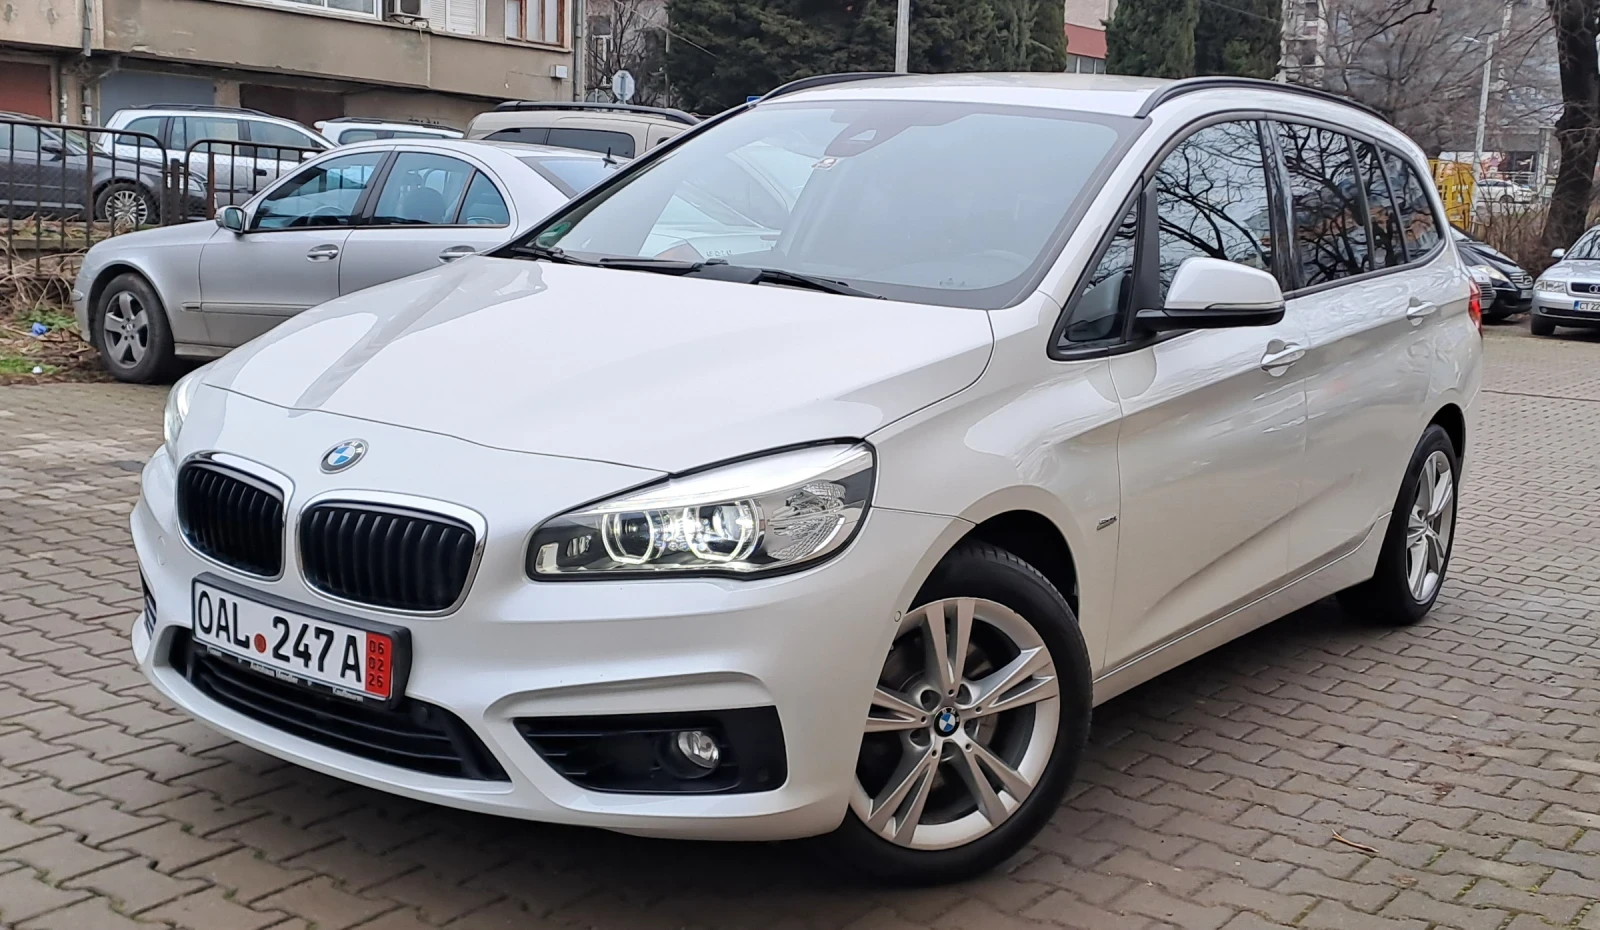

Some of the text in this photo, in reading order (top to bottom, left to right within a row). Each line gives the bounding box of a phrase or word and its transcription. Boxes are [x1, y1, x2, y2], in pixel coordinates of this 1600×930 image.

[198, 590, 250, 649] OAL
[369, 639, 385, 655] 06
[369, 655, 385, 671] 02
[368, 672, 384, 688] 26
